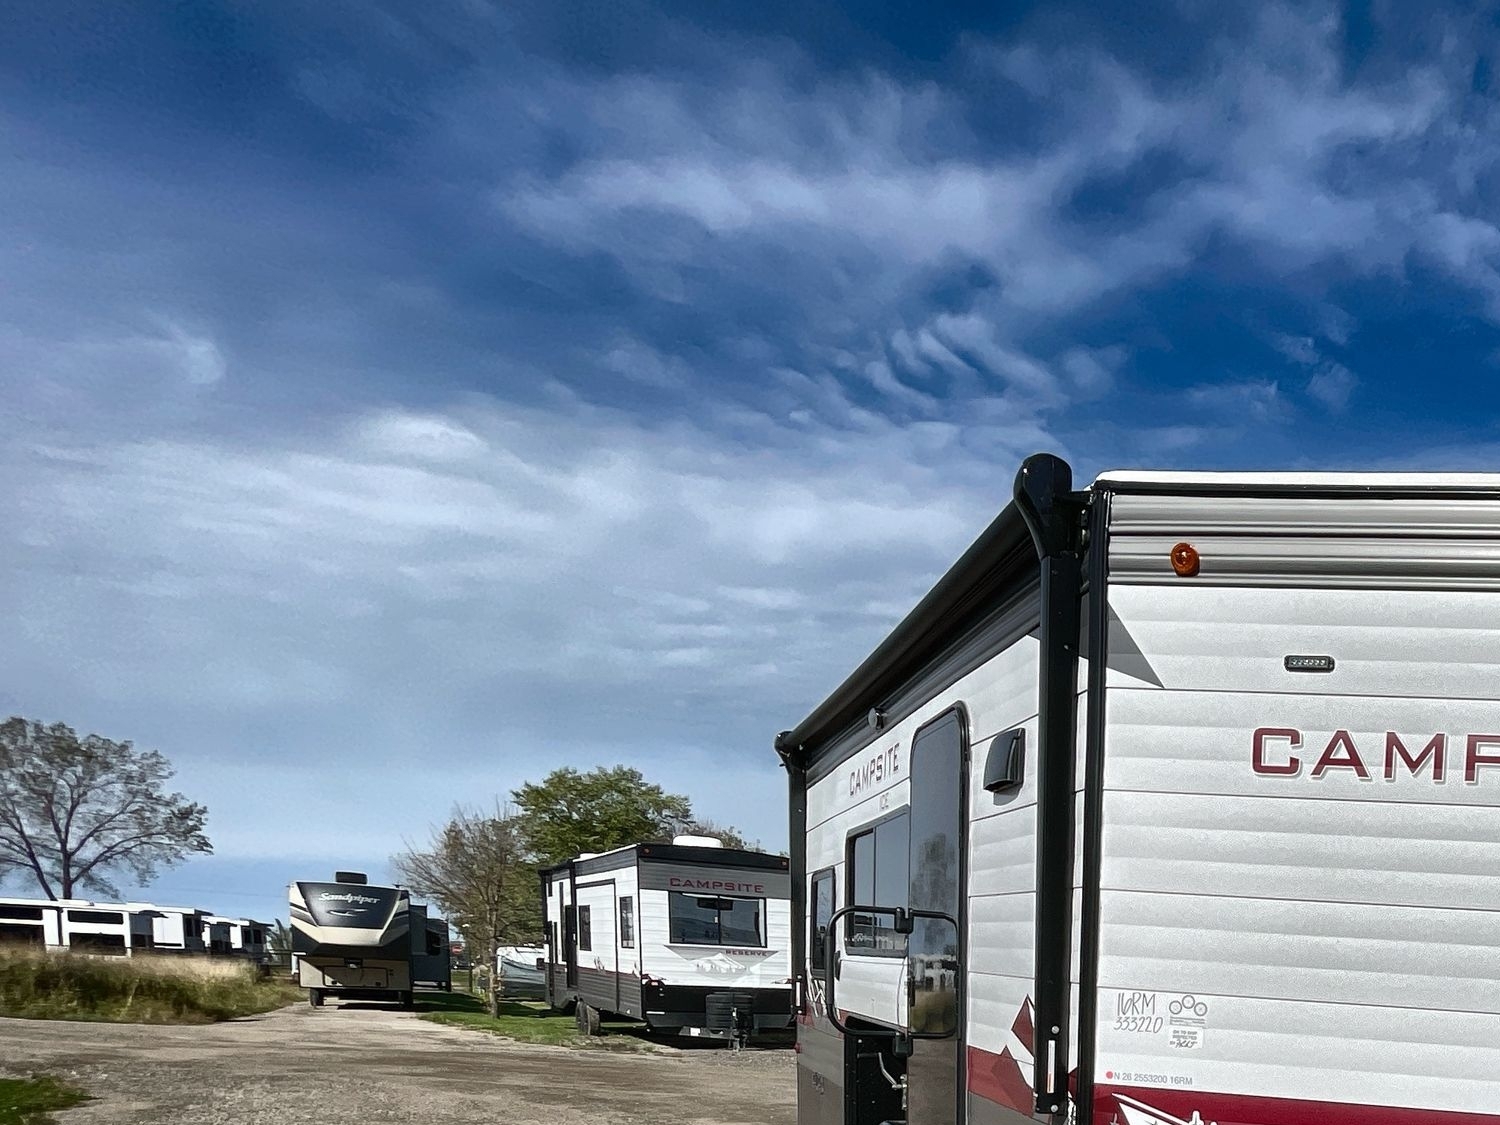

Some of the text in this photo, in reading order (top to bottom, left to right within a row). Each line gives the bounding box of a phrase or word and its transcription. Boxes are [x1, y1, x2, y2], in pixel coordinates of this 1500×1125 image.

[850, 742, 900, 796] CAMPSITE
[669, 877, 764, 893] CAMPSITE
[319, 892, 381, 904] Sandpiper
[726, 949, 768, 957] RESERVE
[1117, 992, 1156, 1016] 16RM
[1113, 1016, 1163, 1034] 333220
[1170, 1076, 1193, 1085] 16RM
